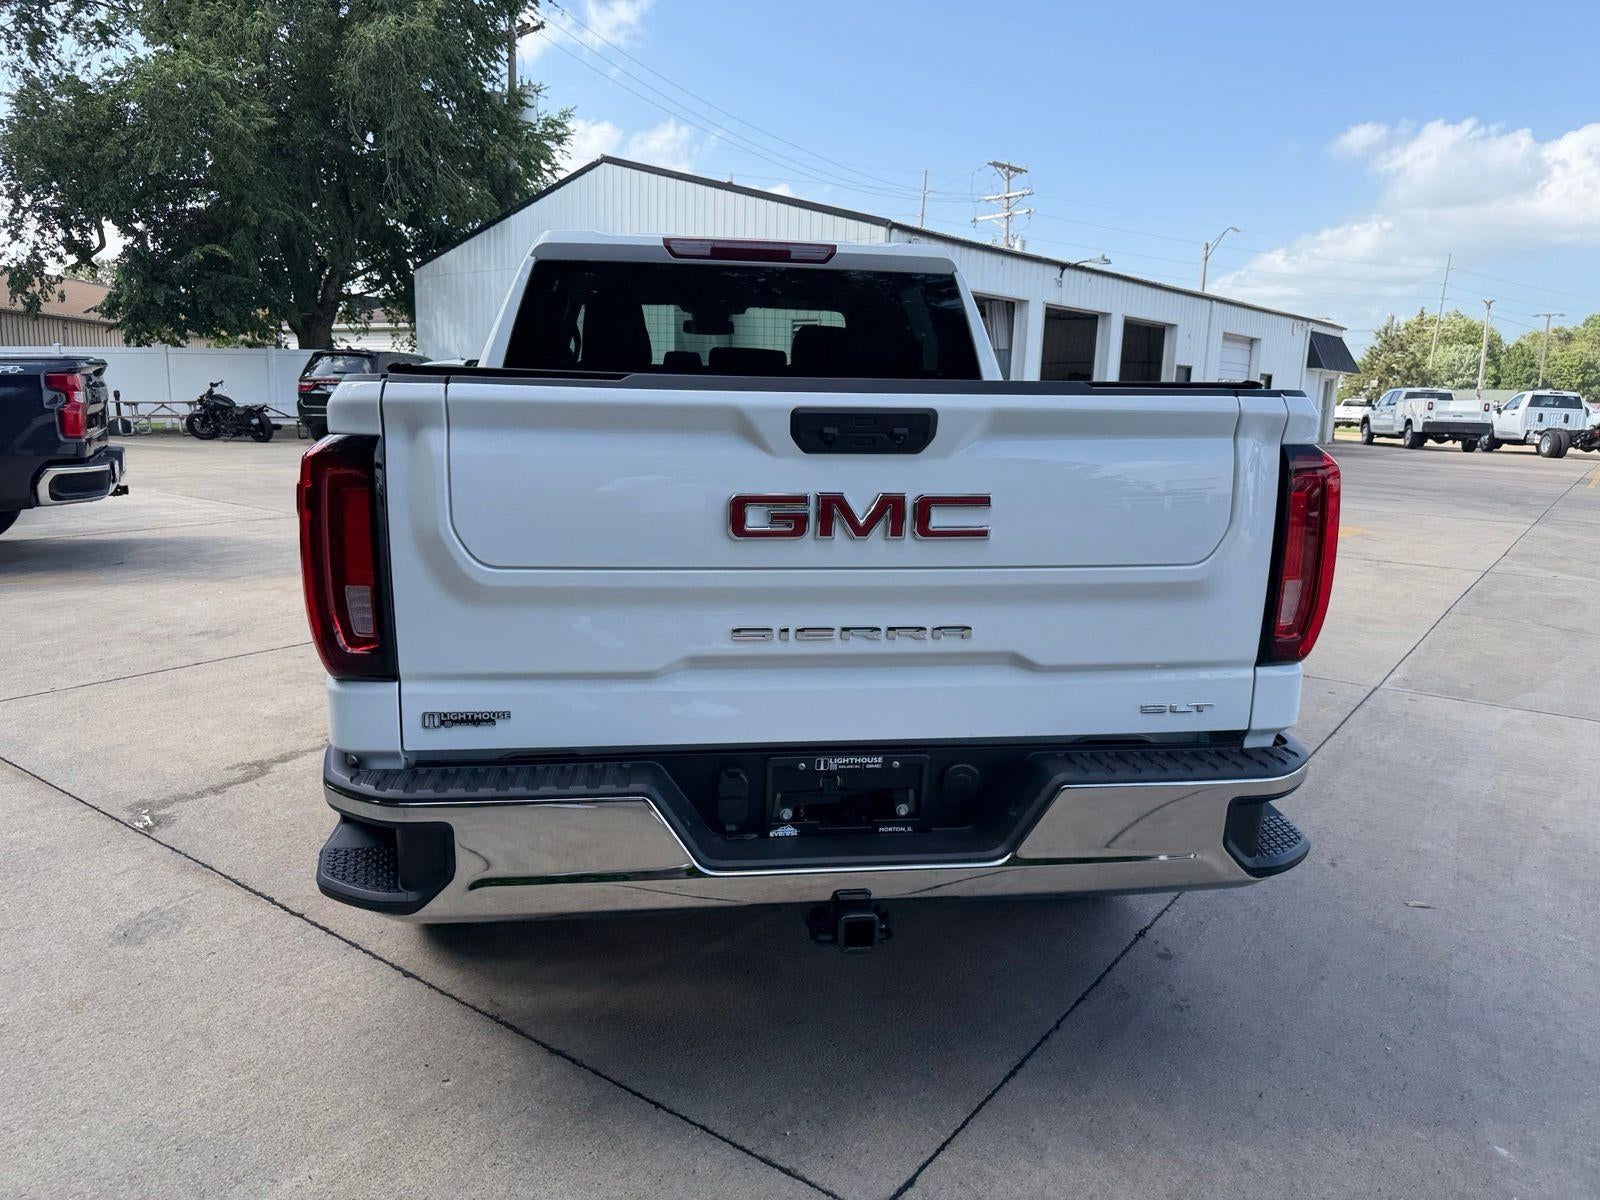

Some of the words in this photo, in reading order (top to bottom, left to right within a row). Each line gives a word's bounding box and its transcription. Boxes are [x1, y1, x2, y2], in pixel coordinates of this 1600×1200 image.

[728, 492, 991, 540] GMC
[731, 626, 972, 641] SIERRA
[1140, 702, 1214, 713] SLT
[441, 711, 511, 720] LIGHTHOUSE
